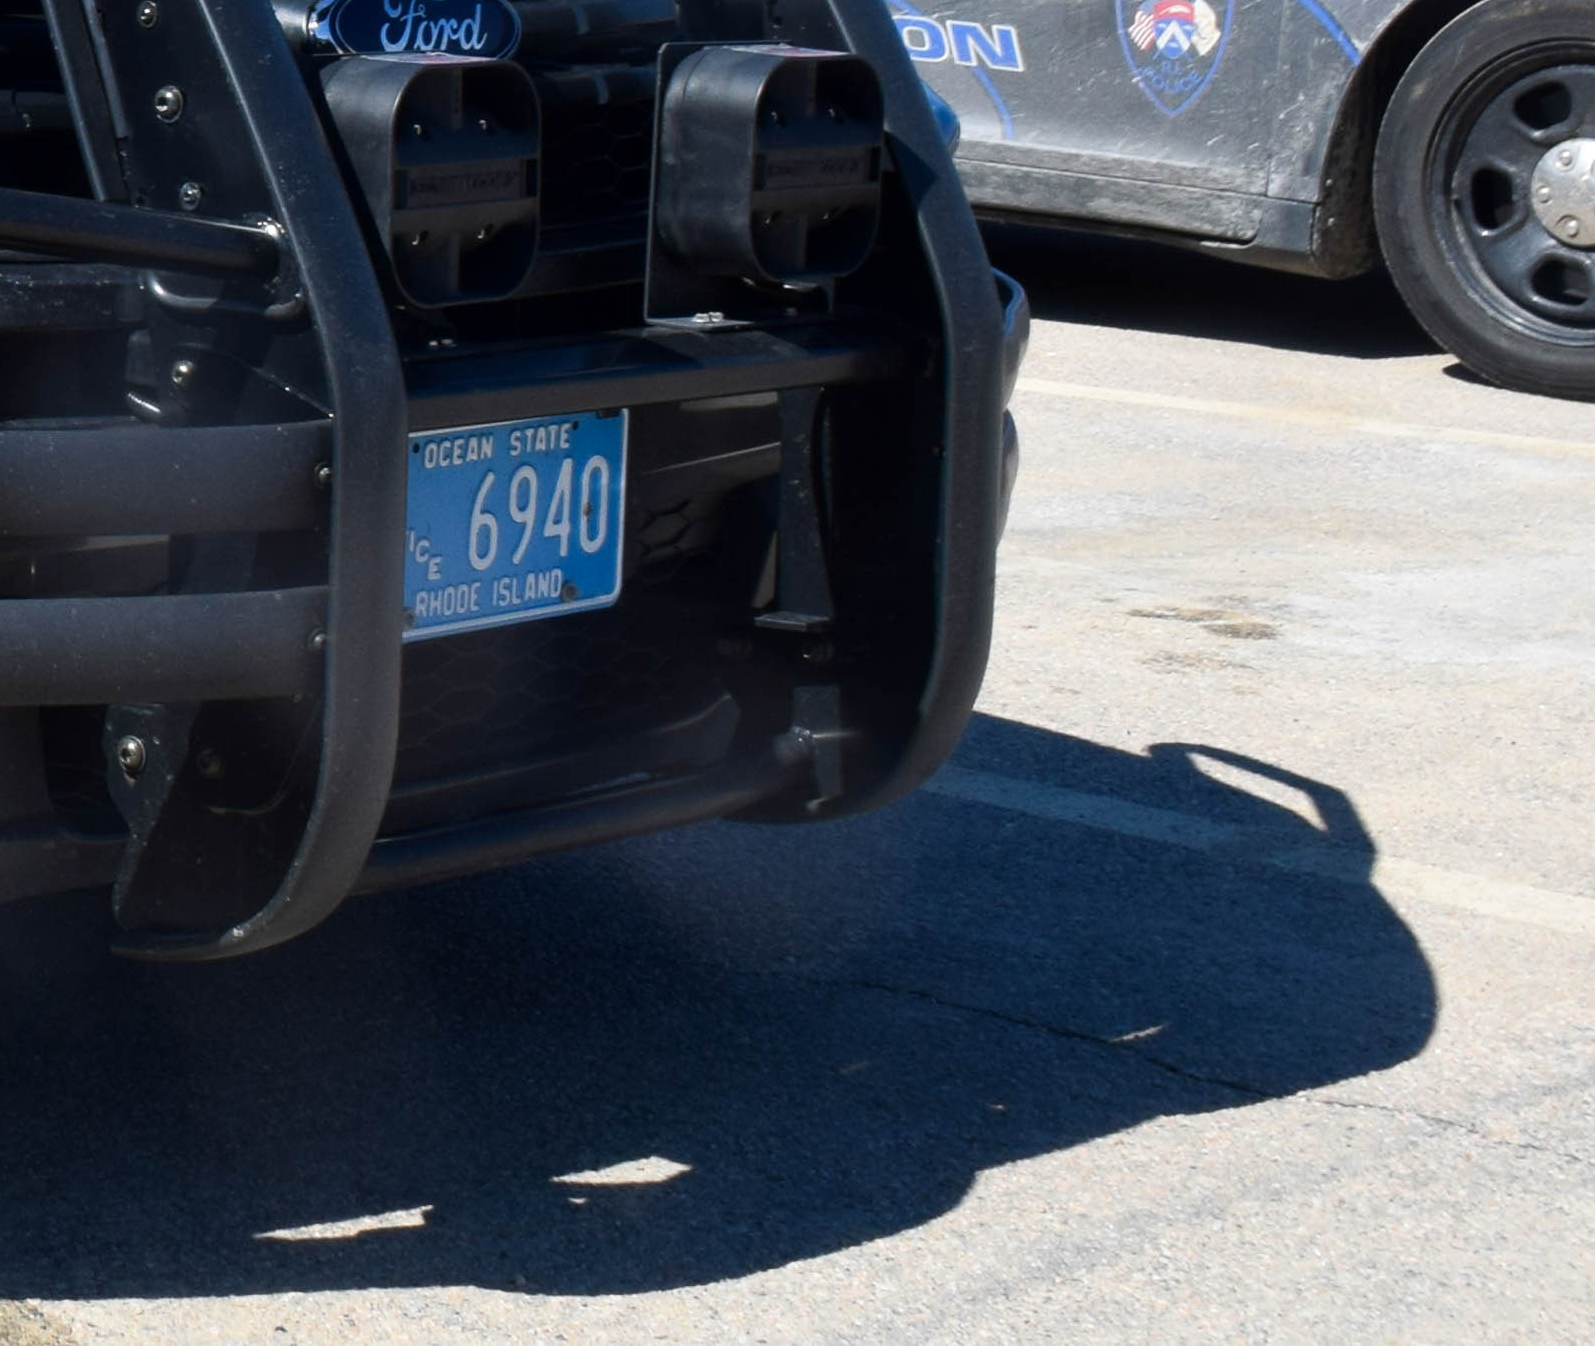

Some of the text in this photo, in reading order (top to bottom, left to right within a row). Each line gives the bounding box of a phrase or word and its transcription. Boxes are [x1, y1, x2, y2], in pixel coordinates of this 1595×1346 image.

[1137, 66, 1203, 94] POLICE
[424, 423, 571, 469] OCEAN STATE
[469, 455, 609, 572] 6940
[407, 530, 442, 581] ICE
[415, 568, 563, 618] RHODE ISLAND
